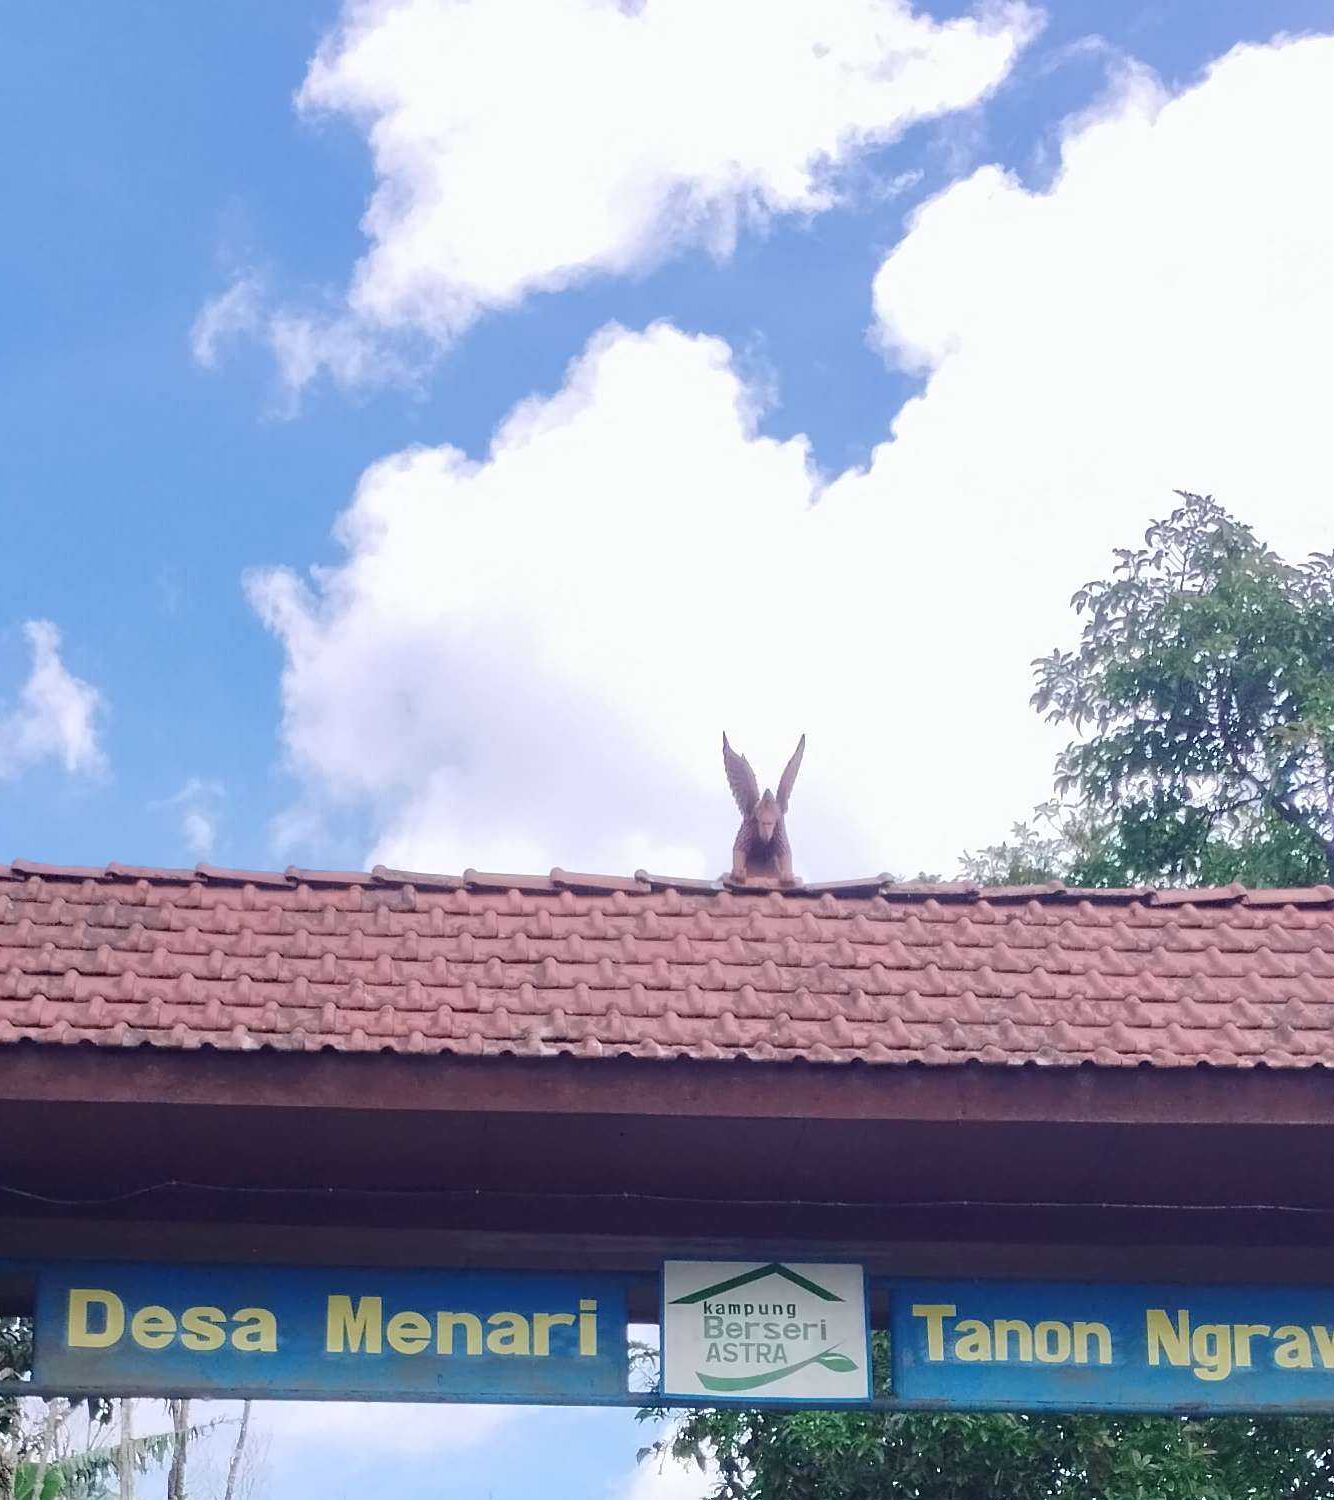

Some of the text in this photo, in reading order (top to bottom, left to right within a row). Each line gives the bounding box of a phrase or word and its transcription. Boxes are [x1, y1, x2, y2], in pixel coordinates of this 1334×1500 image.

[68, 1287, 598, 1357] Desa Menari
[703, 1301, 796, 1319] kampung
[703, 1315, 827, 1341] Berseri
[911, 1303, 1113, 1365] Tanon
[706, 1342, 787, 1363] ASTRA
